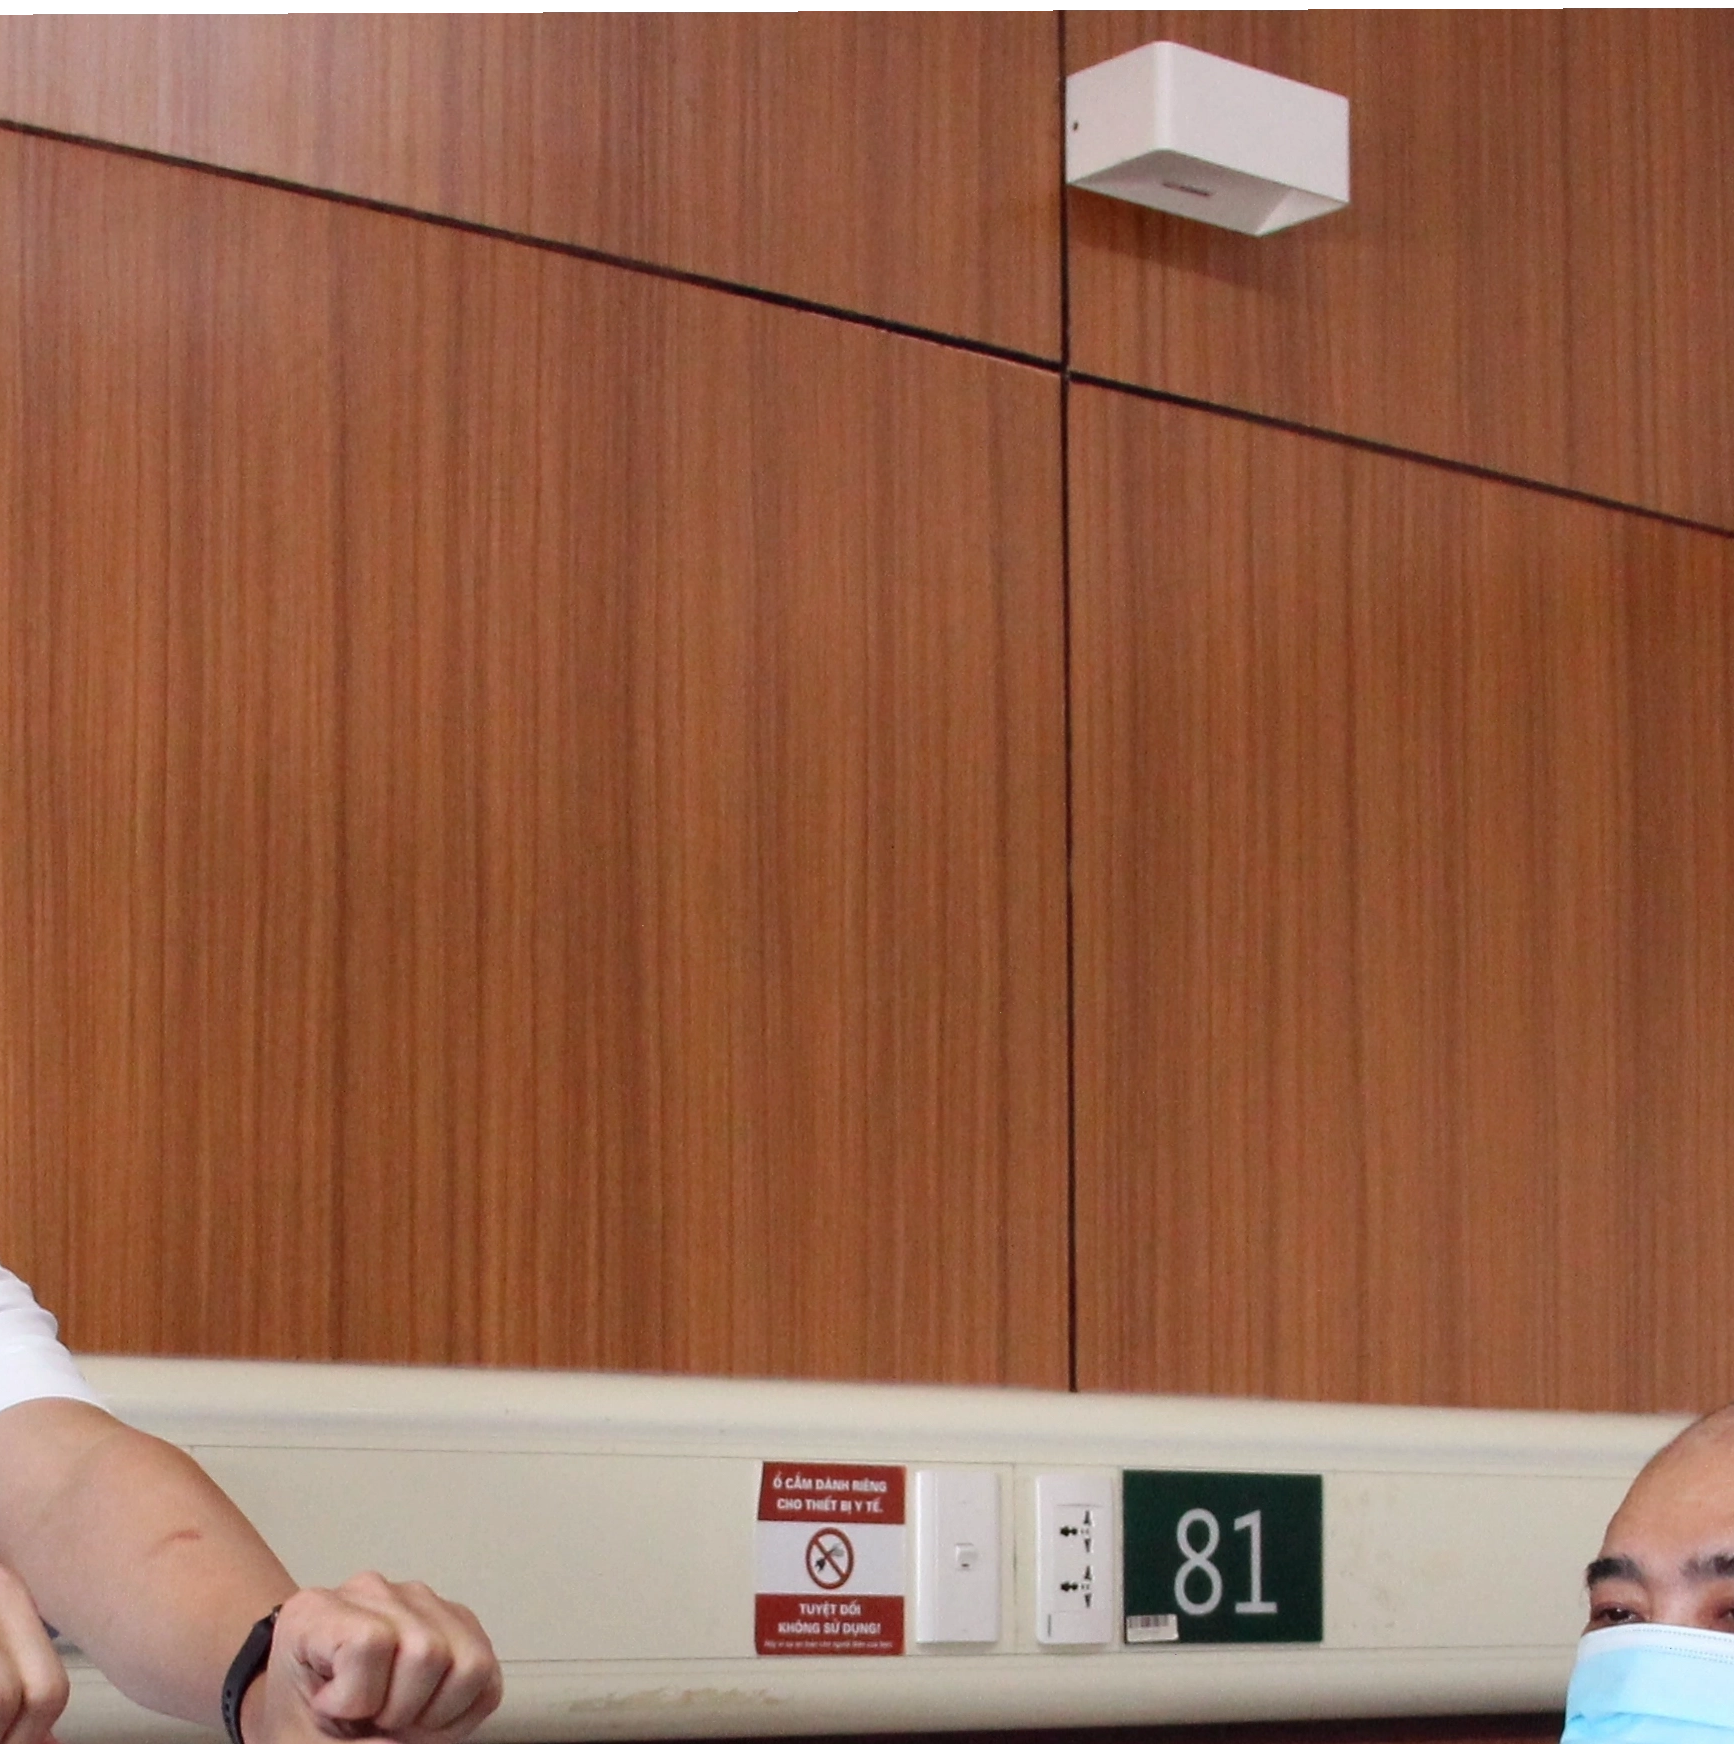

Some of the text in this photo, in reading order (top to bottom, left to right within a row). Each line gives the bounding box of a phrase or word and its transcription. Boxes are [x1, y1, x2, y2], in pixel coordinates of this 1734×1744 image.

[852, 1477, 888, 1493] RIÊNG
[776, 1498, 803, 1511] CHO
[805, 1495, 838, 1512] THIẾT
[840, 1500, 852, 1515] BỊ
[854, 1500, 863, 1513] Y
[1173, 1507, 1279, 1617] 81
[799, 1599, 862, 1617] TUYỆT ĐỐI
[777, 1618, 821, 1634] KHÔNG
[842, 1622, 882, 1637] DỤNG!
